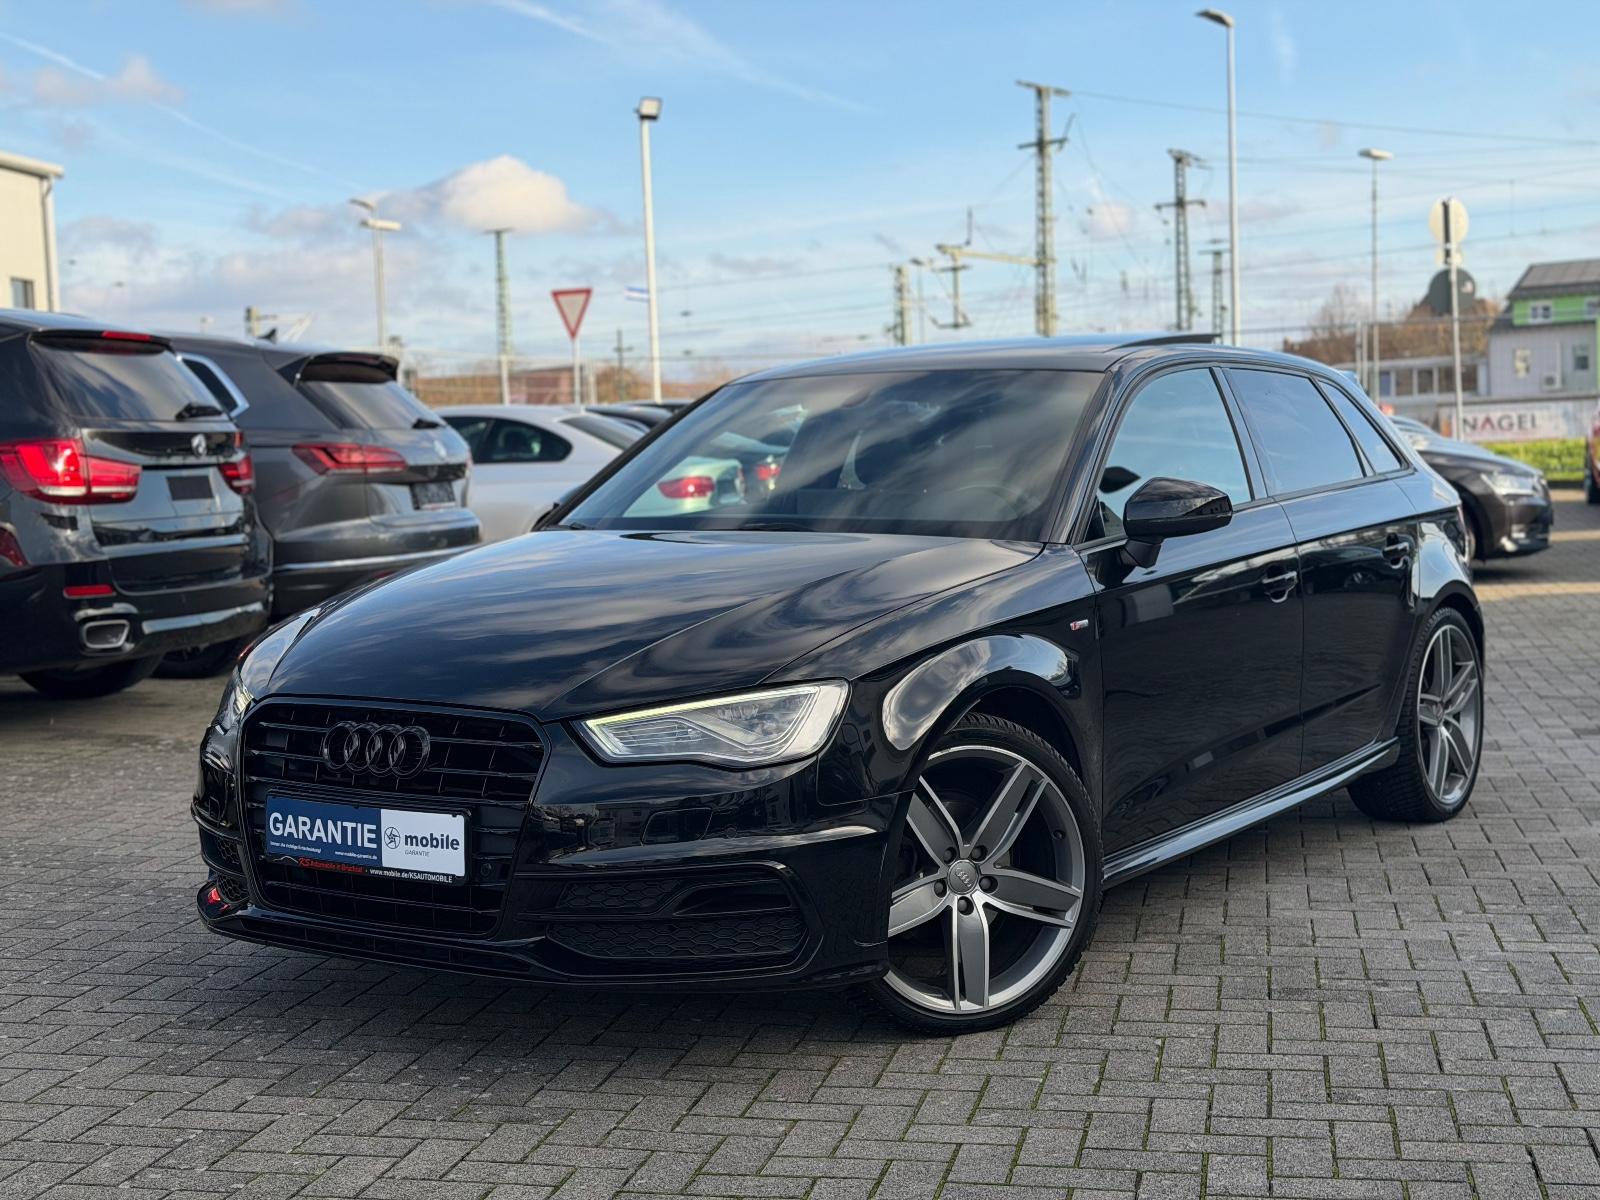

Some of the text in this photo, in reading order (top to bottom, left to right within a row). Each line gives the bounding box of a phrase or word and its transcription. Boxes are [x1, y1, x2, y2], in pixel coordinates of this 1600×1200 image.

[269, 812, 378, 849] GARANTIE
[404, 832, 460, 851] mobile
[404, 849, 431, 857] GARANTIE
[369, 868, 453, 883] www.mobile.de/KSAUTOMOBILE
